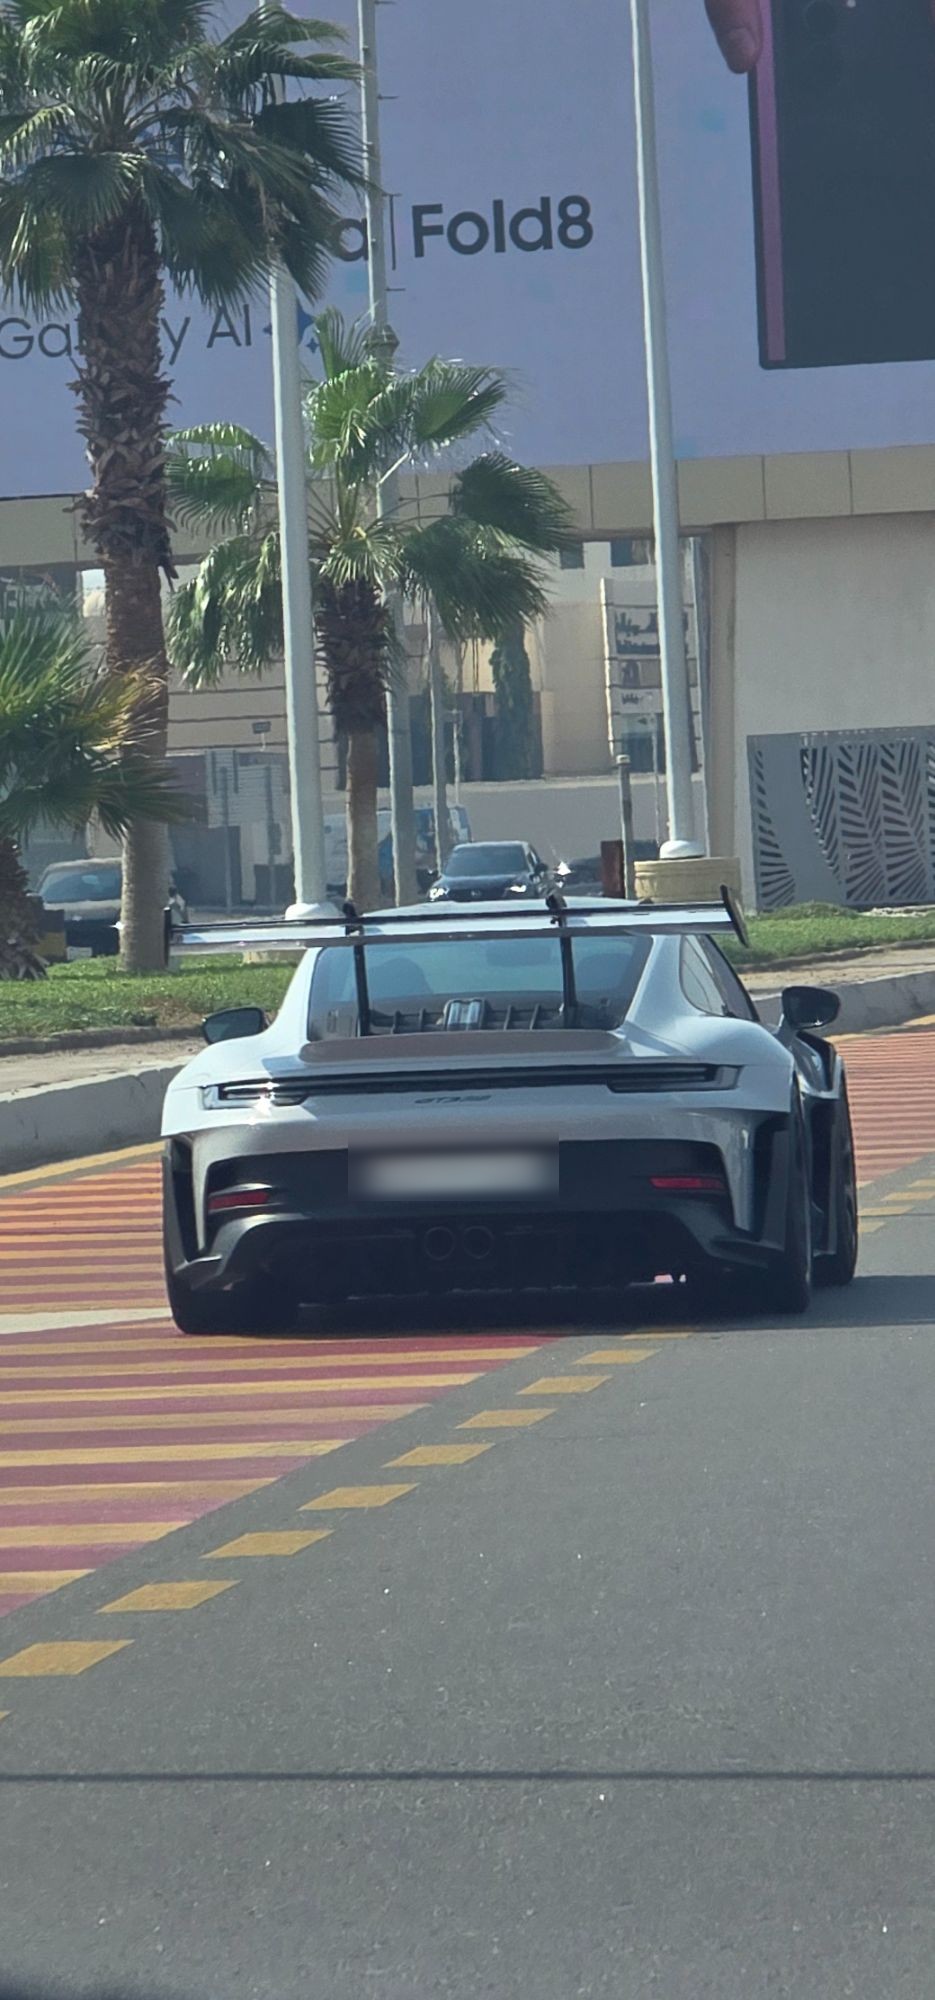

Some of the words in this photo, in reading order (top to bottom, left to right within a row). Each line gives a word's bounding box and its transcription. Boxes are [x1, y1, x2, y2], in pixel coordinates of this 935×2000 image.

[412, 195, 593, 258] Fold8
[0, 316, 191, 365] Gay
[206, 303, 252, 348] AI
